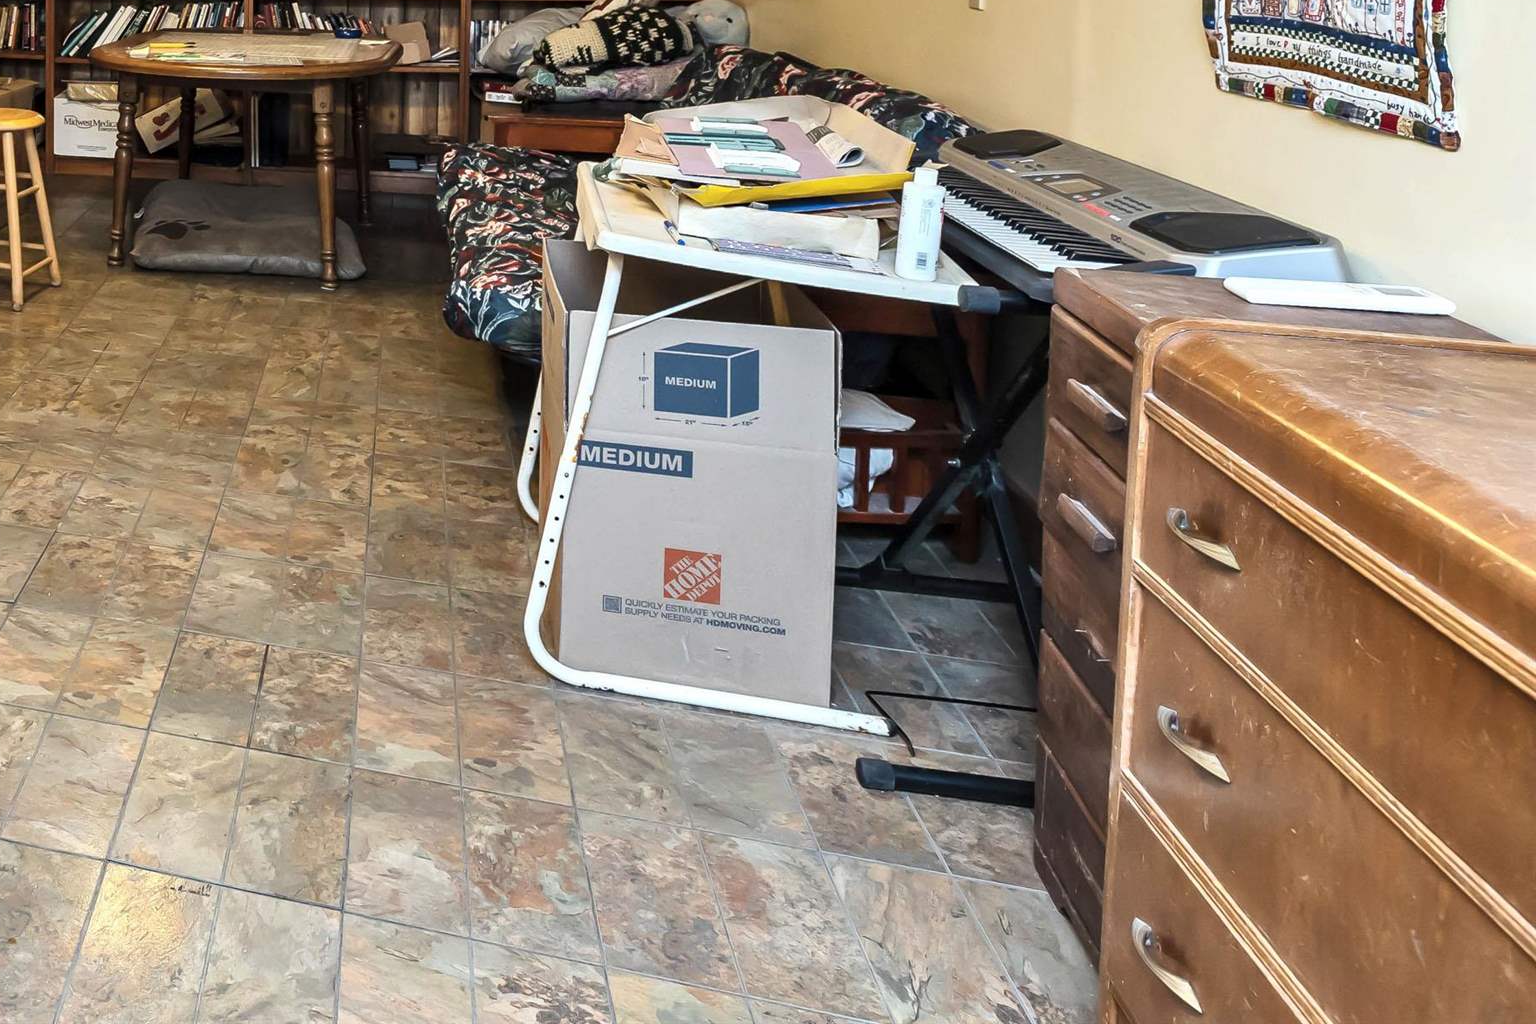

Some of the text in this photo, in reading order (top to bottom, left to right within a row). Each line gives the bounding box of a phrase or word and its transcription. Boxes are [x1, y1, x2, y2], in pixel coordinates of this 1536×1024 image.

[1266, 38, 1281, 48] love
[1308, 44, 1332, 59] things
[1337, 53, 1383, 72] handmade
[1386, 99, 1405, 115] busy
[665, 376, 717, 390] MEDIUM
[581, 445, 683, 473] MEDIUM
[664, 552, 719, 599] HOME
[670, 555, 694, 575] THE
[686, 573, 721, 602] DEPOT
[625, 598, 781, 627] QUICKLY ESTIMATE YOUR PACKING
[625, 606, 787, 636] SUPPLY NEEDS AT HDMOVING.COM
